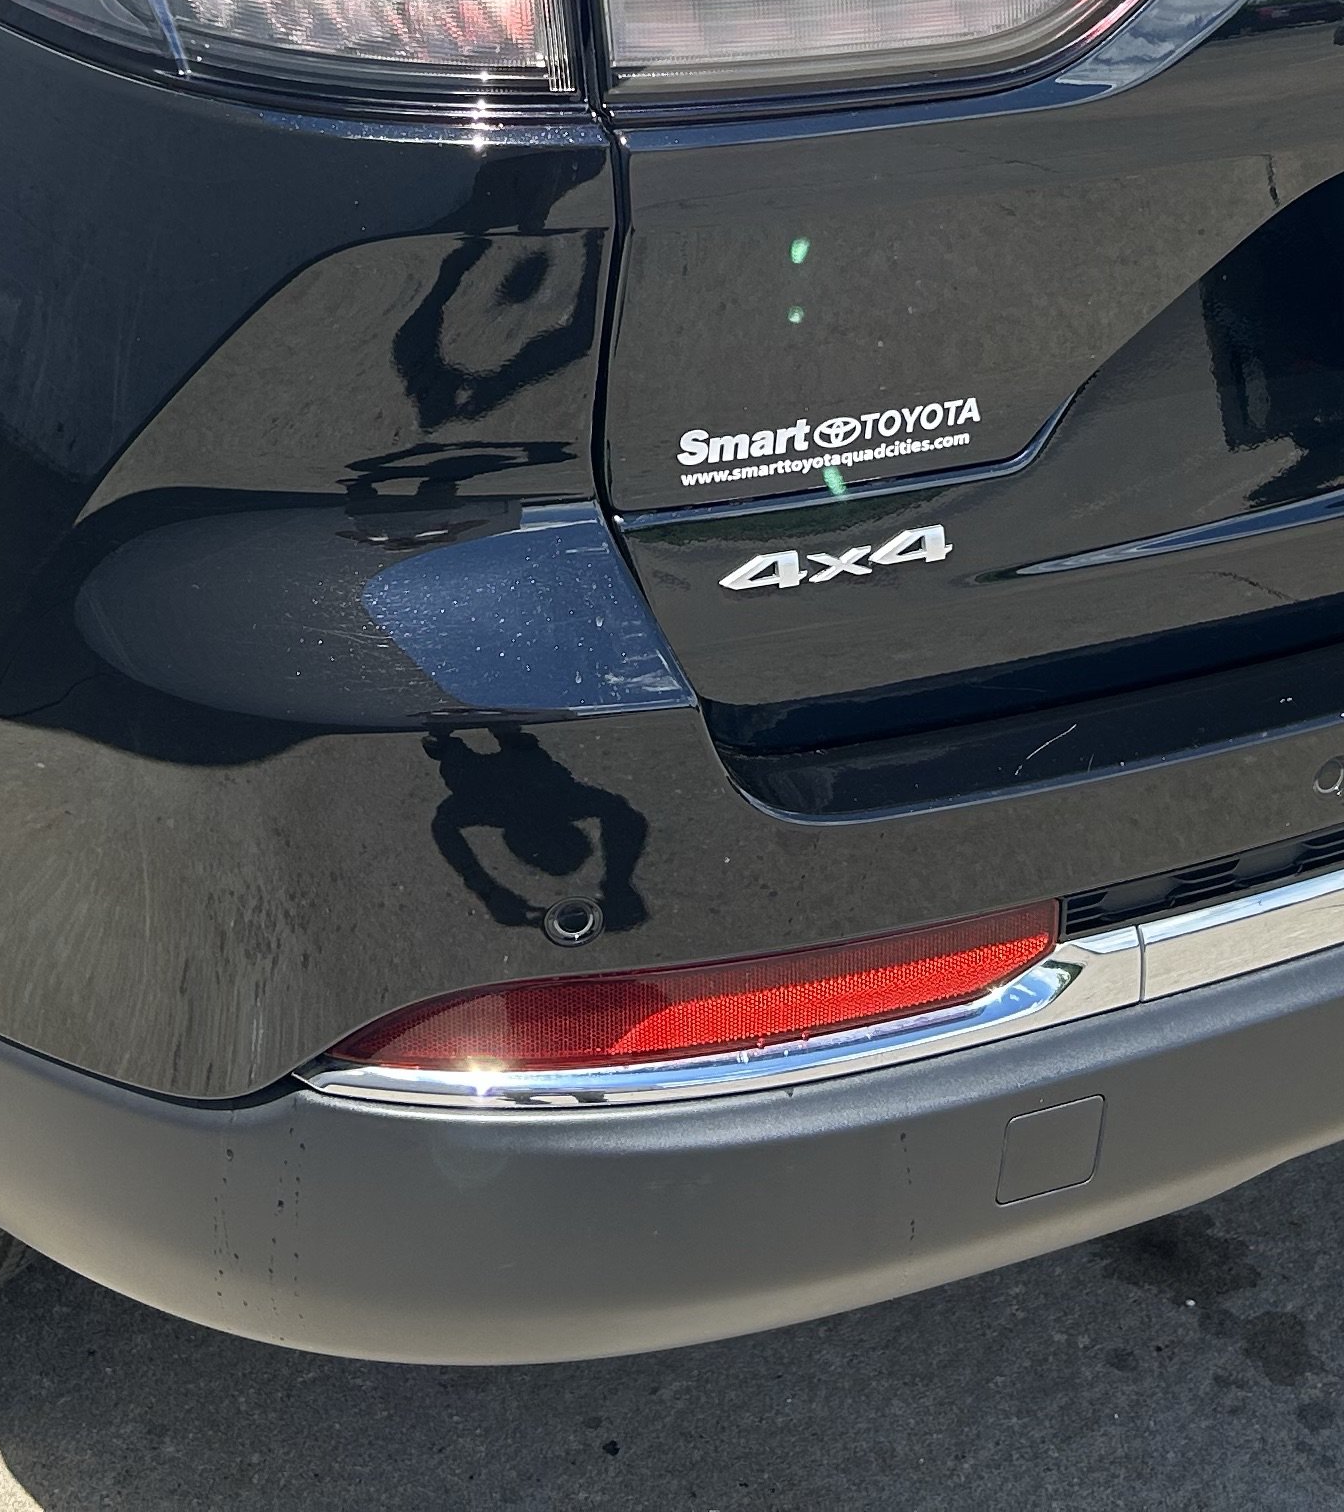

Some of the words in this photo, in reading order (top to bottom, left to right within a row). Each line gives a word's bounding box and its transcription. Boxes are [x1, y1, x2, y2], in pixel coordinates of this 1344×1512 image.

[677, 418, 811, 466] Smart
[860, 397, 982, 440] TOYOTA
[681, 432, 971, 486] www.smarttoyotaquadcities.com
[718, 524, 953, 591] 4x4
